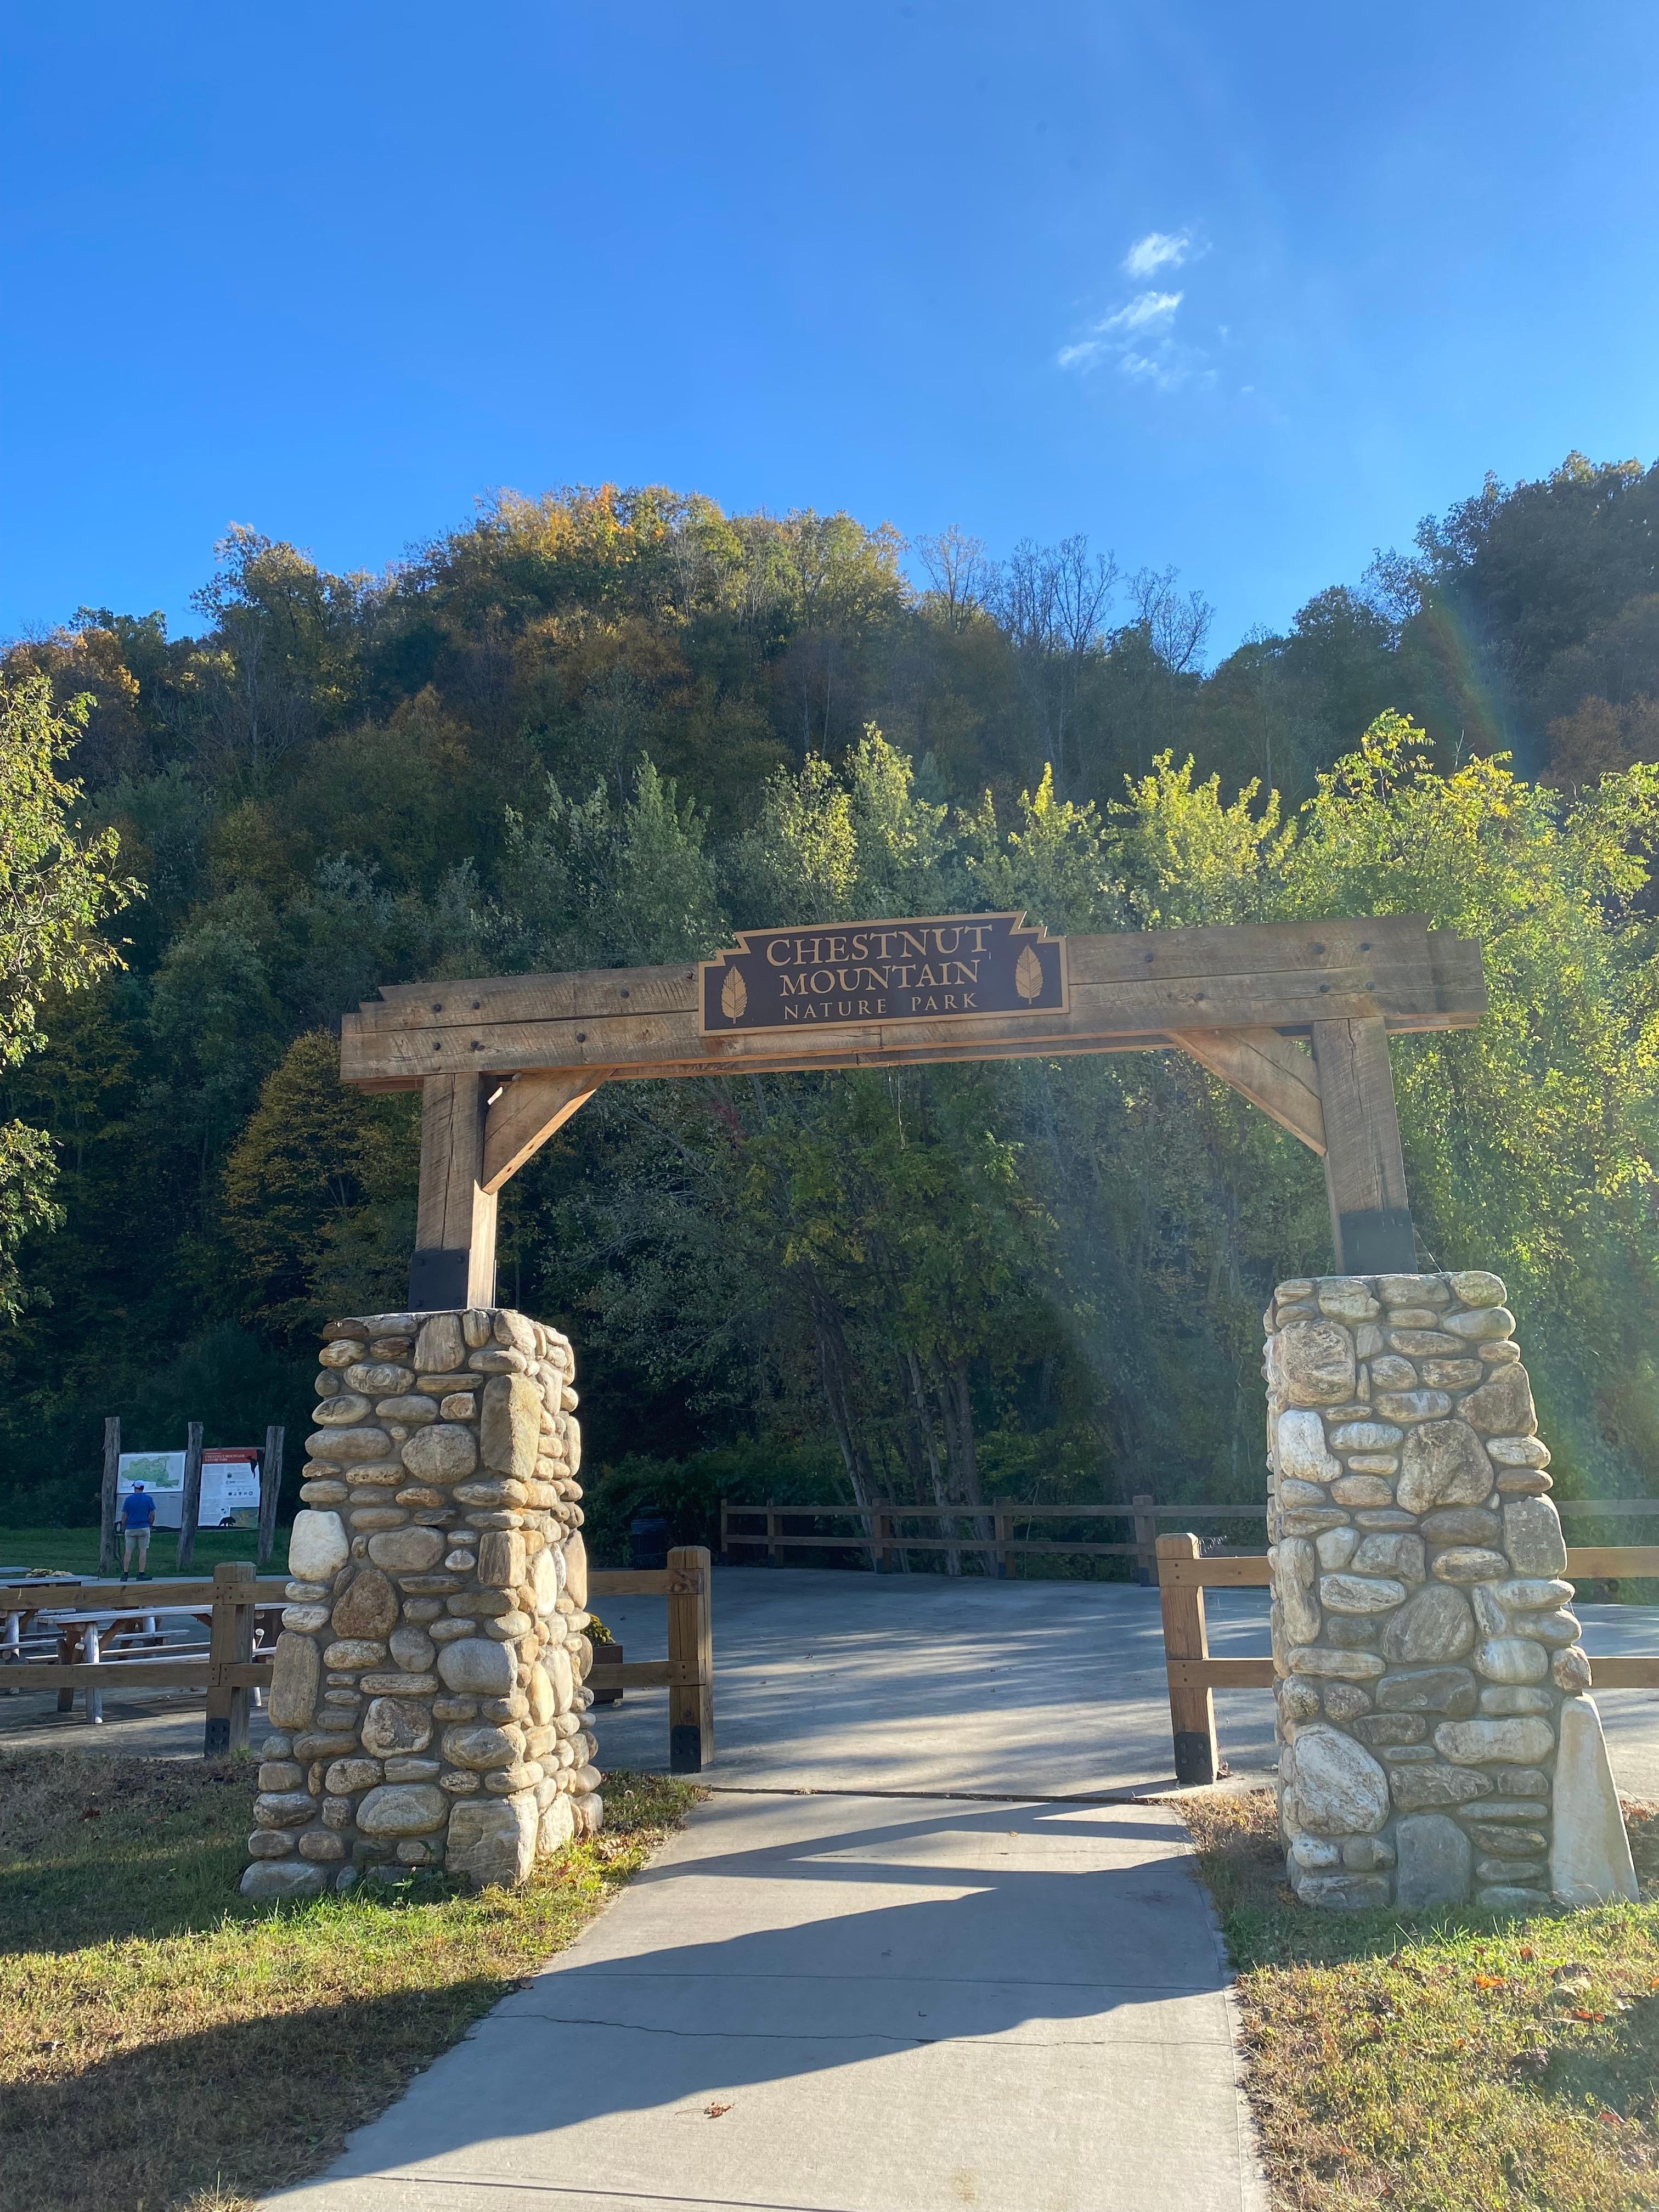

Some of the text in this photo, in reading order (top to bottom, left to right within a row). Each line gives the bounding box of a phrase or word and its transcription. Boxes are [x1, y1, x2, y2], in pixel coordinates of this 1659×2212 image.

[766, 924, 992, 966] CHESTNUT
[780, 960, 979, 997] MOUNTAIN
[783, 992, 979, 1020] NATURE PARK
